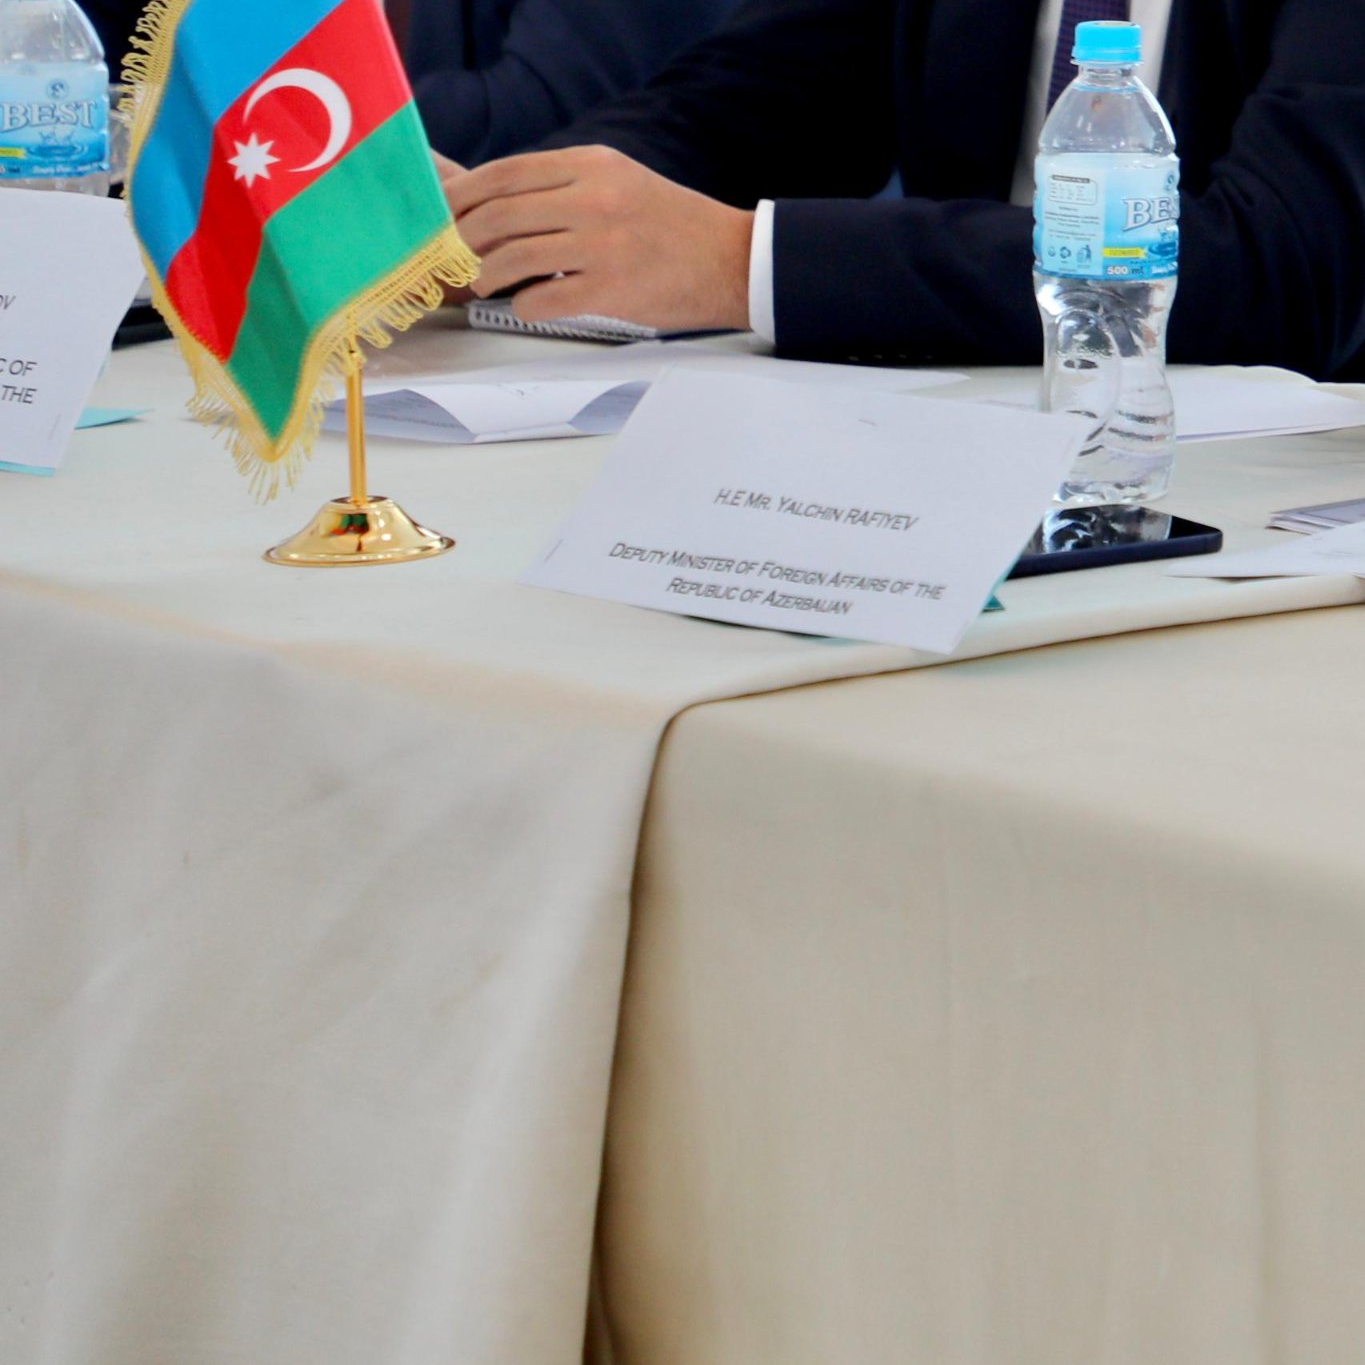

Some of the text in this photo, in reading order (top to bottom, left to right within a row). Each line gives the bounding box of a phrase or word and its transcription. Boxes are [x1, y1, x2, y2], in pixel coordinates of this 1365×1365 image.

[0, 100, 97, 132] BEST
[8, 359, 38, 376] OF
[1, 385, 37, 404] THE
[777, 496, 844, 522] YALCHIN
[843, 508, 919, 531] RAFIYEV
[609, 543, 945, 600] DEPUTY MINISTER OF FOREIGN AFFAIRS OF THE
[666, 577, 736, 601] REPUBLIC
[739, 588, 763, 604] OF
